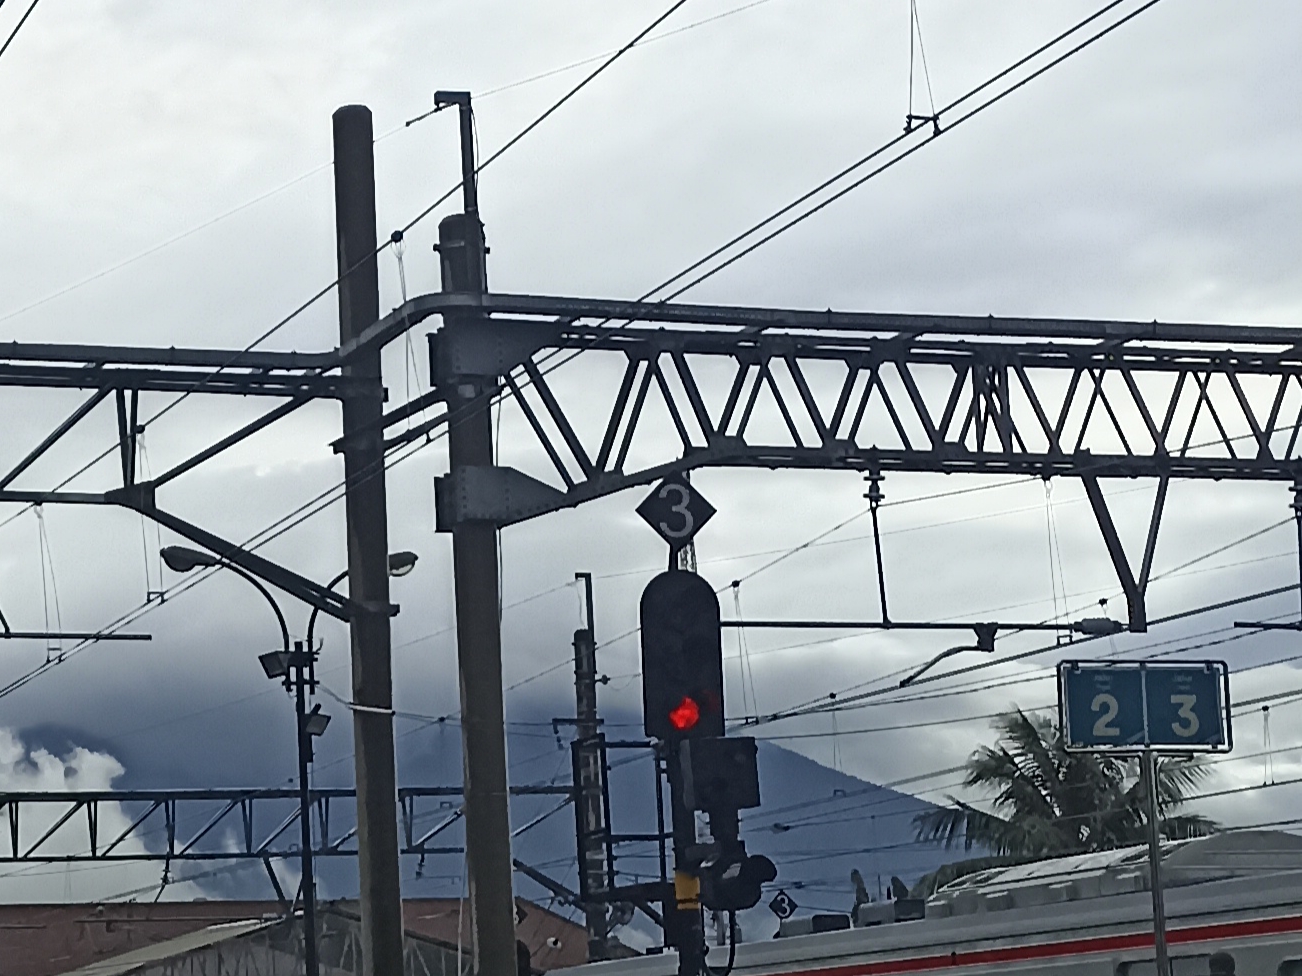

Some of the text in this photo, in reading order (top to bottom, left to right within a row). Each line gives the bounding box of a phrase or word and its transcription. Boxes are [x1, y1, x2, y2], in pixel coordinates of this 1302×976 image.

[658, 483, 694, 538] 3
[1090, 693, 1120, 737] 2
[1170, 694, 1200, 738] 3
[776, 894, 791, 918] 3
